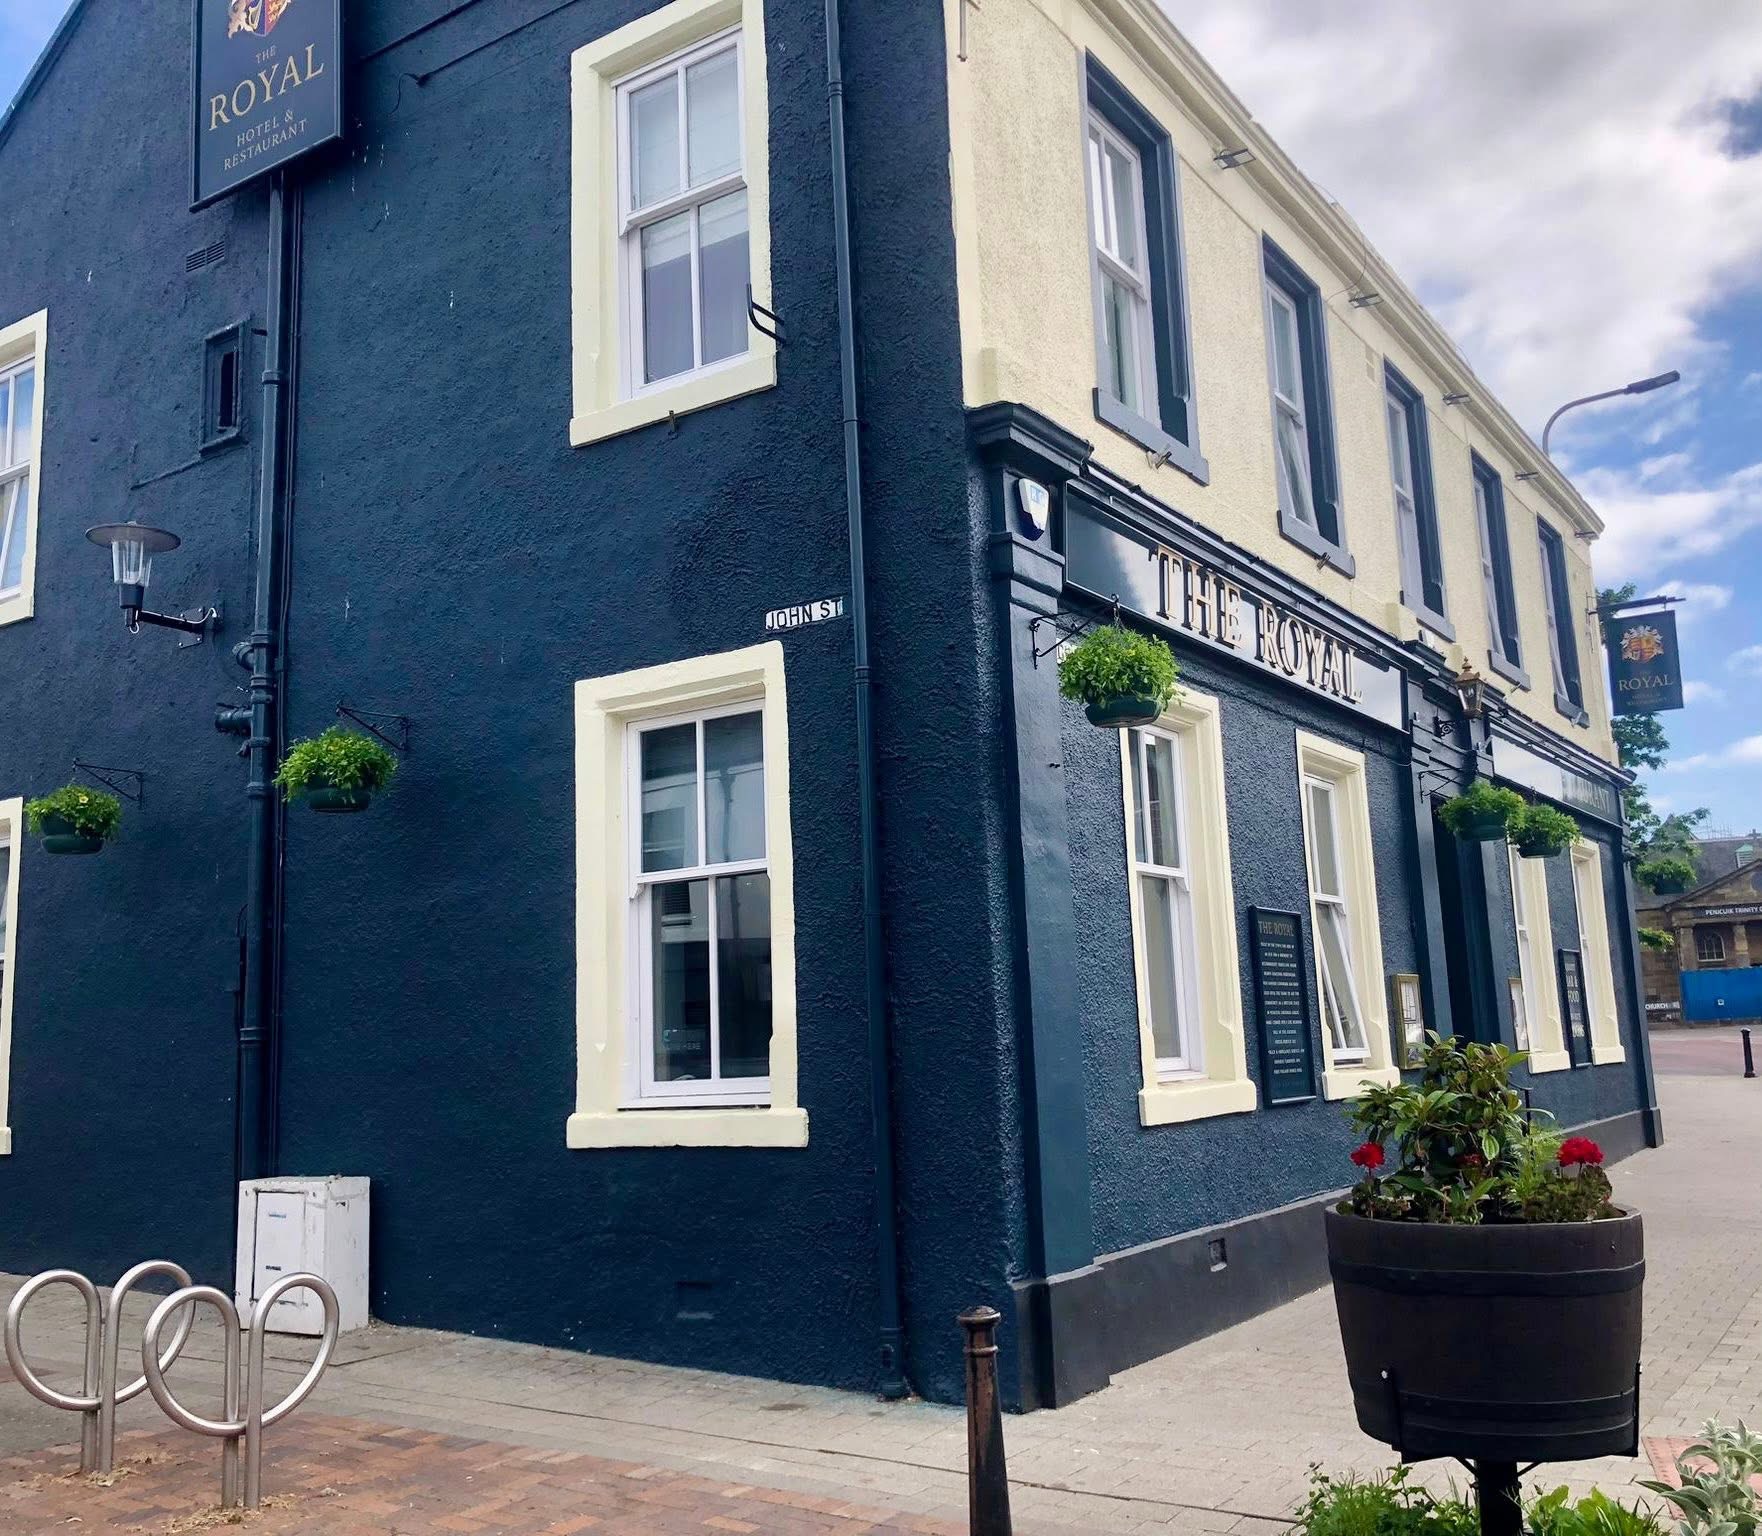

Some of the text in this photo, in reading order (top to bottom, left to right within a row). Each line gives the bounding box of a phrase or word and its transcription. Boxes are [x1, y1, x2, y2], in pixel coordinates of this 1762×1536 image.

[255, 45, 277, 64] THE
[208, 43, 324, 132] ROYAL
[223, 118, 307, 171] RESTAURANT
[236, 109, 294, 147] HOTEL &
[767, 598, 842, 629] JOHN ST
[1149, 544, 1363, 704] THE ROYAL
[1618, 673, 1673, 692] ROYAL
[1258, 920, 1295, 937] THE ROYAL
